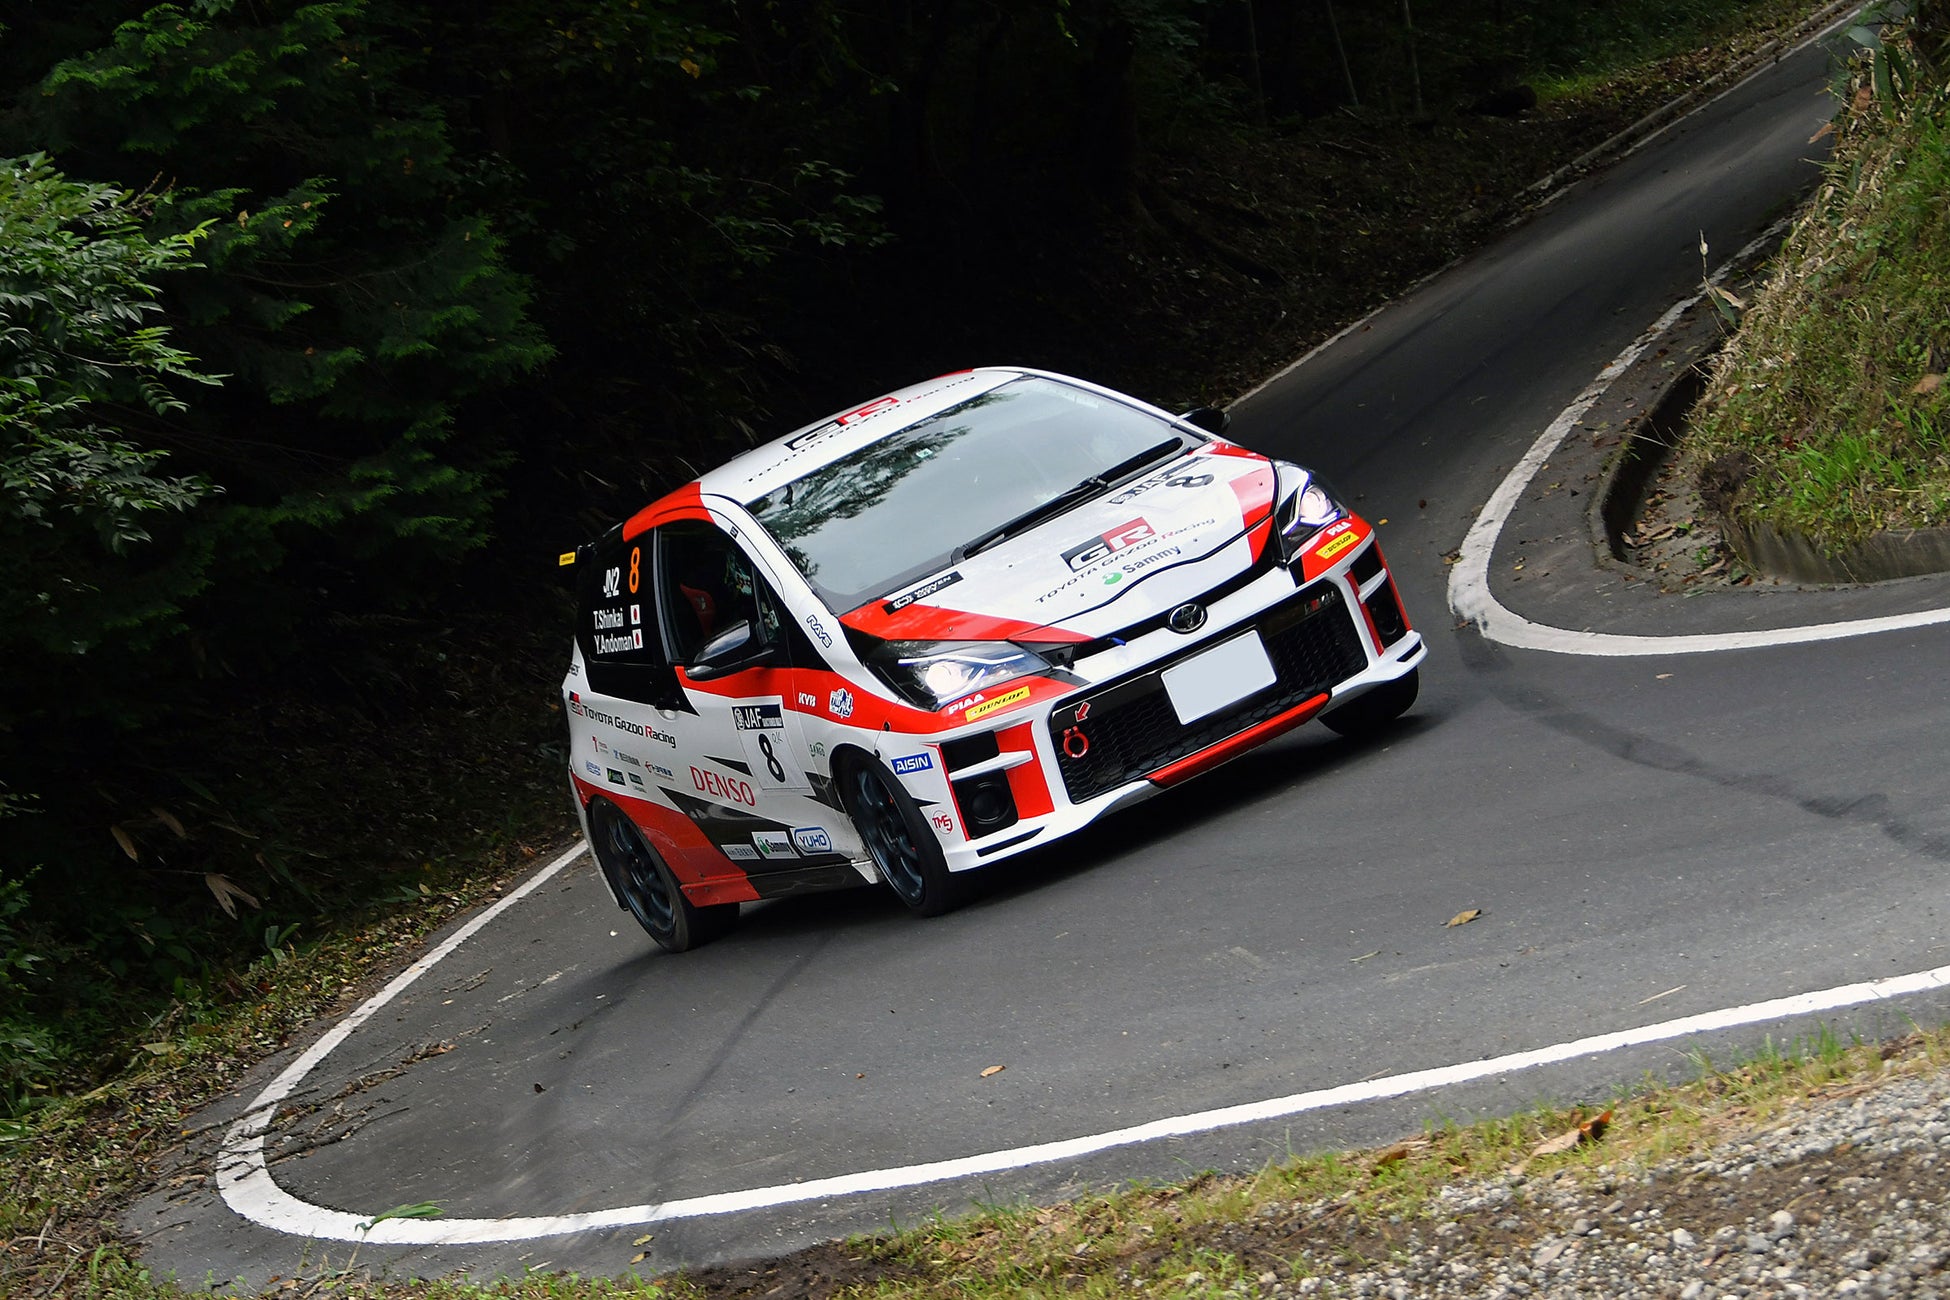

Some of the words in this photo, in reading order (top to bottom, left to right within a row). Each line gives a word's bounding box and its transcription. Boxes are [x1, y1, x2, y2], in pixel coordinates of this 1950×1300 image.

[1136, 473, 1168, 494] JAF
[1165, 473, 1214, 488] 8
[1062, 518, 1156, 572] GR
[629, 547, 640, 593] 8
[1035, 567, 1098, 604] TOYOTA
[1101, 539, 1158, 567] GAZOO
[1161, 518, 1216, 540] Racing
[1122, 545, 1182, 574] Sammy
[603, 567, 620, 597] JN2
[593, 607, 624, 630] T.Shinkai
[806, 614, 832, 648] RAYS
[594, 633, 634, 654] Y.Andoman
[798, 692, 816, 707] KYB
[947, 693, 984, 715] PIAA
[978, 691, 1023, 713] DUNLOP
[583, 705, 614, 726] TOYOTA
[615, 717, 643, 736] GAZOO
[645, 725, 676, 749] Racing
[744, 707, 761, 728] JAF
[758, 733, 785, 783] 8
[896, 756, 928, 772] AISIN
[689, 766, 755, 806] DENSO
[765, 839, 794, 854] Sammy
[799, 835, 827, 848] YUHO
